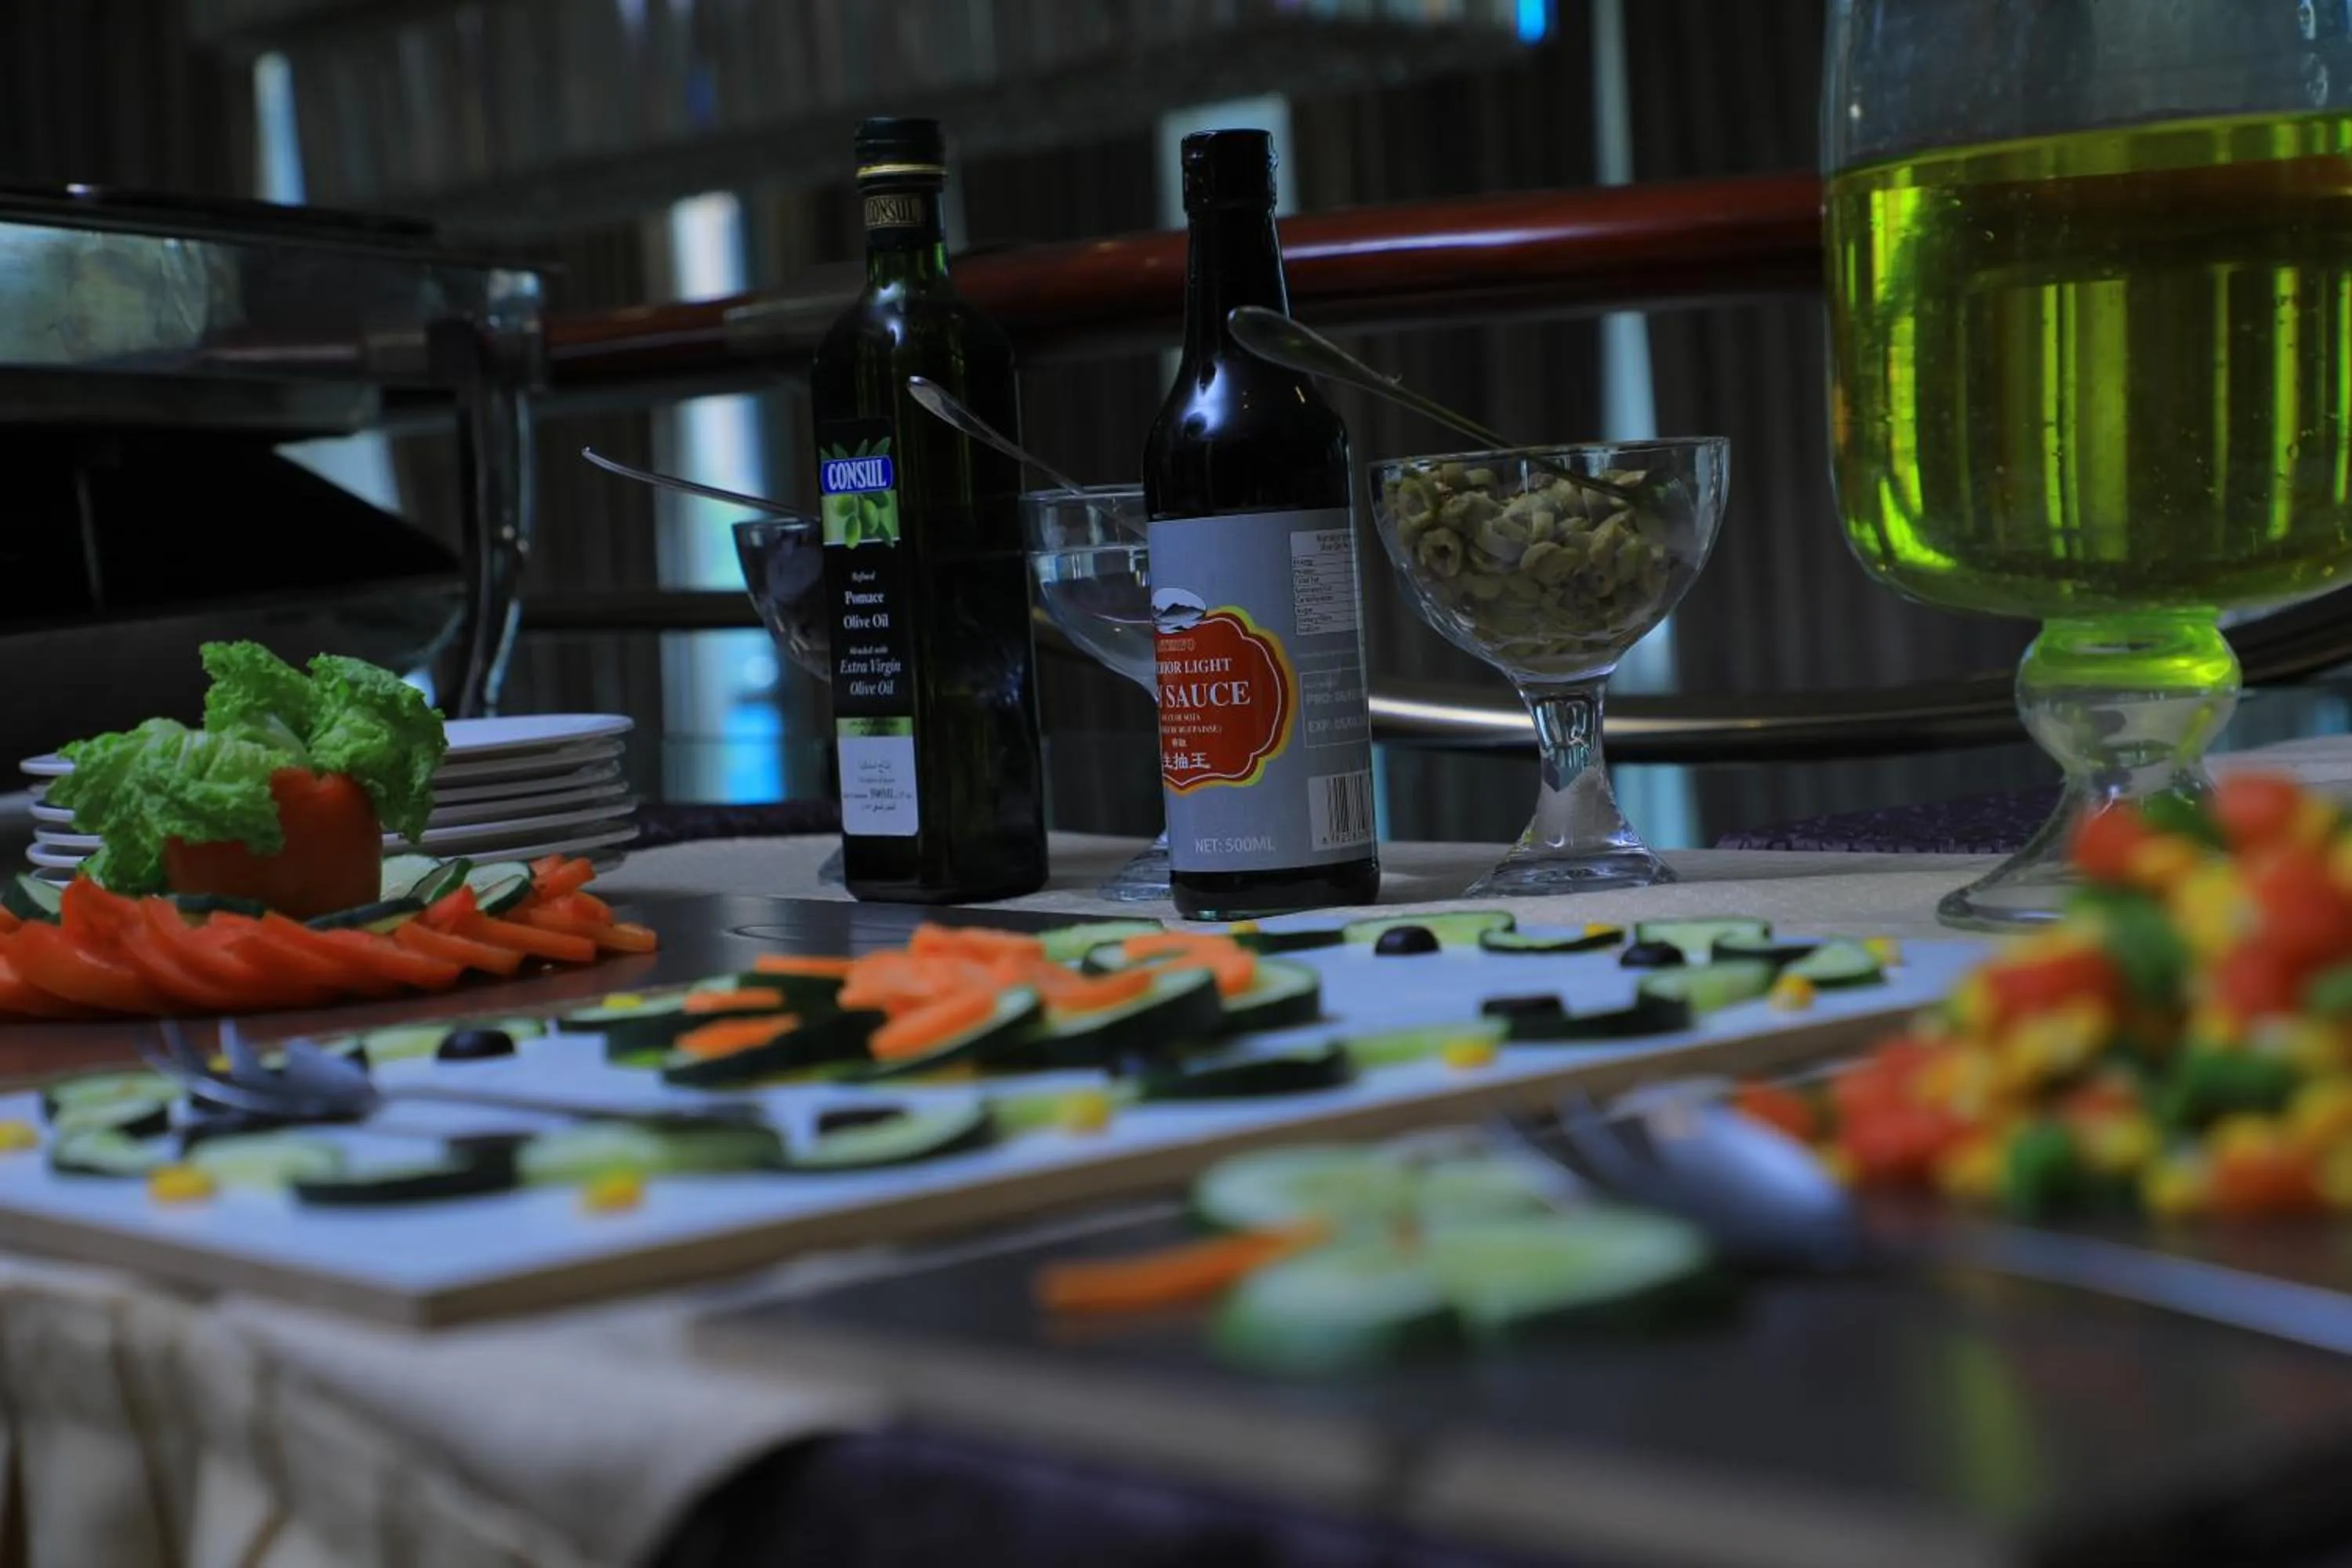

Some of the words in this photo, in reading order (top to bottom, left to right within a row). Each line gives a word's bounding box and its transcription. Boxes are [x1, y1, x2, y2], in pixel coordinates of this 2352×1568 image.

[827, 459, 887, 490] CONSUL
[844, 590, 884, 605] Pomace
[843, 614, 870, 629] Olive
[872, 613, 889, 627] Oil
[840, 659, 868, 674] Extra
[869, 657, 902, 677] Virgin
[1185, 658, 1232, 673] LIGHT
[849, 680, 876, 695] Olive
[877, 678, 895, 695] Oil
[1166, 681, 1251, 708] SAUCE
